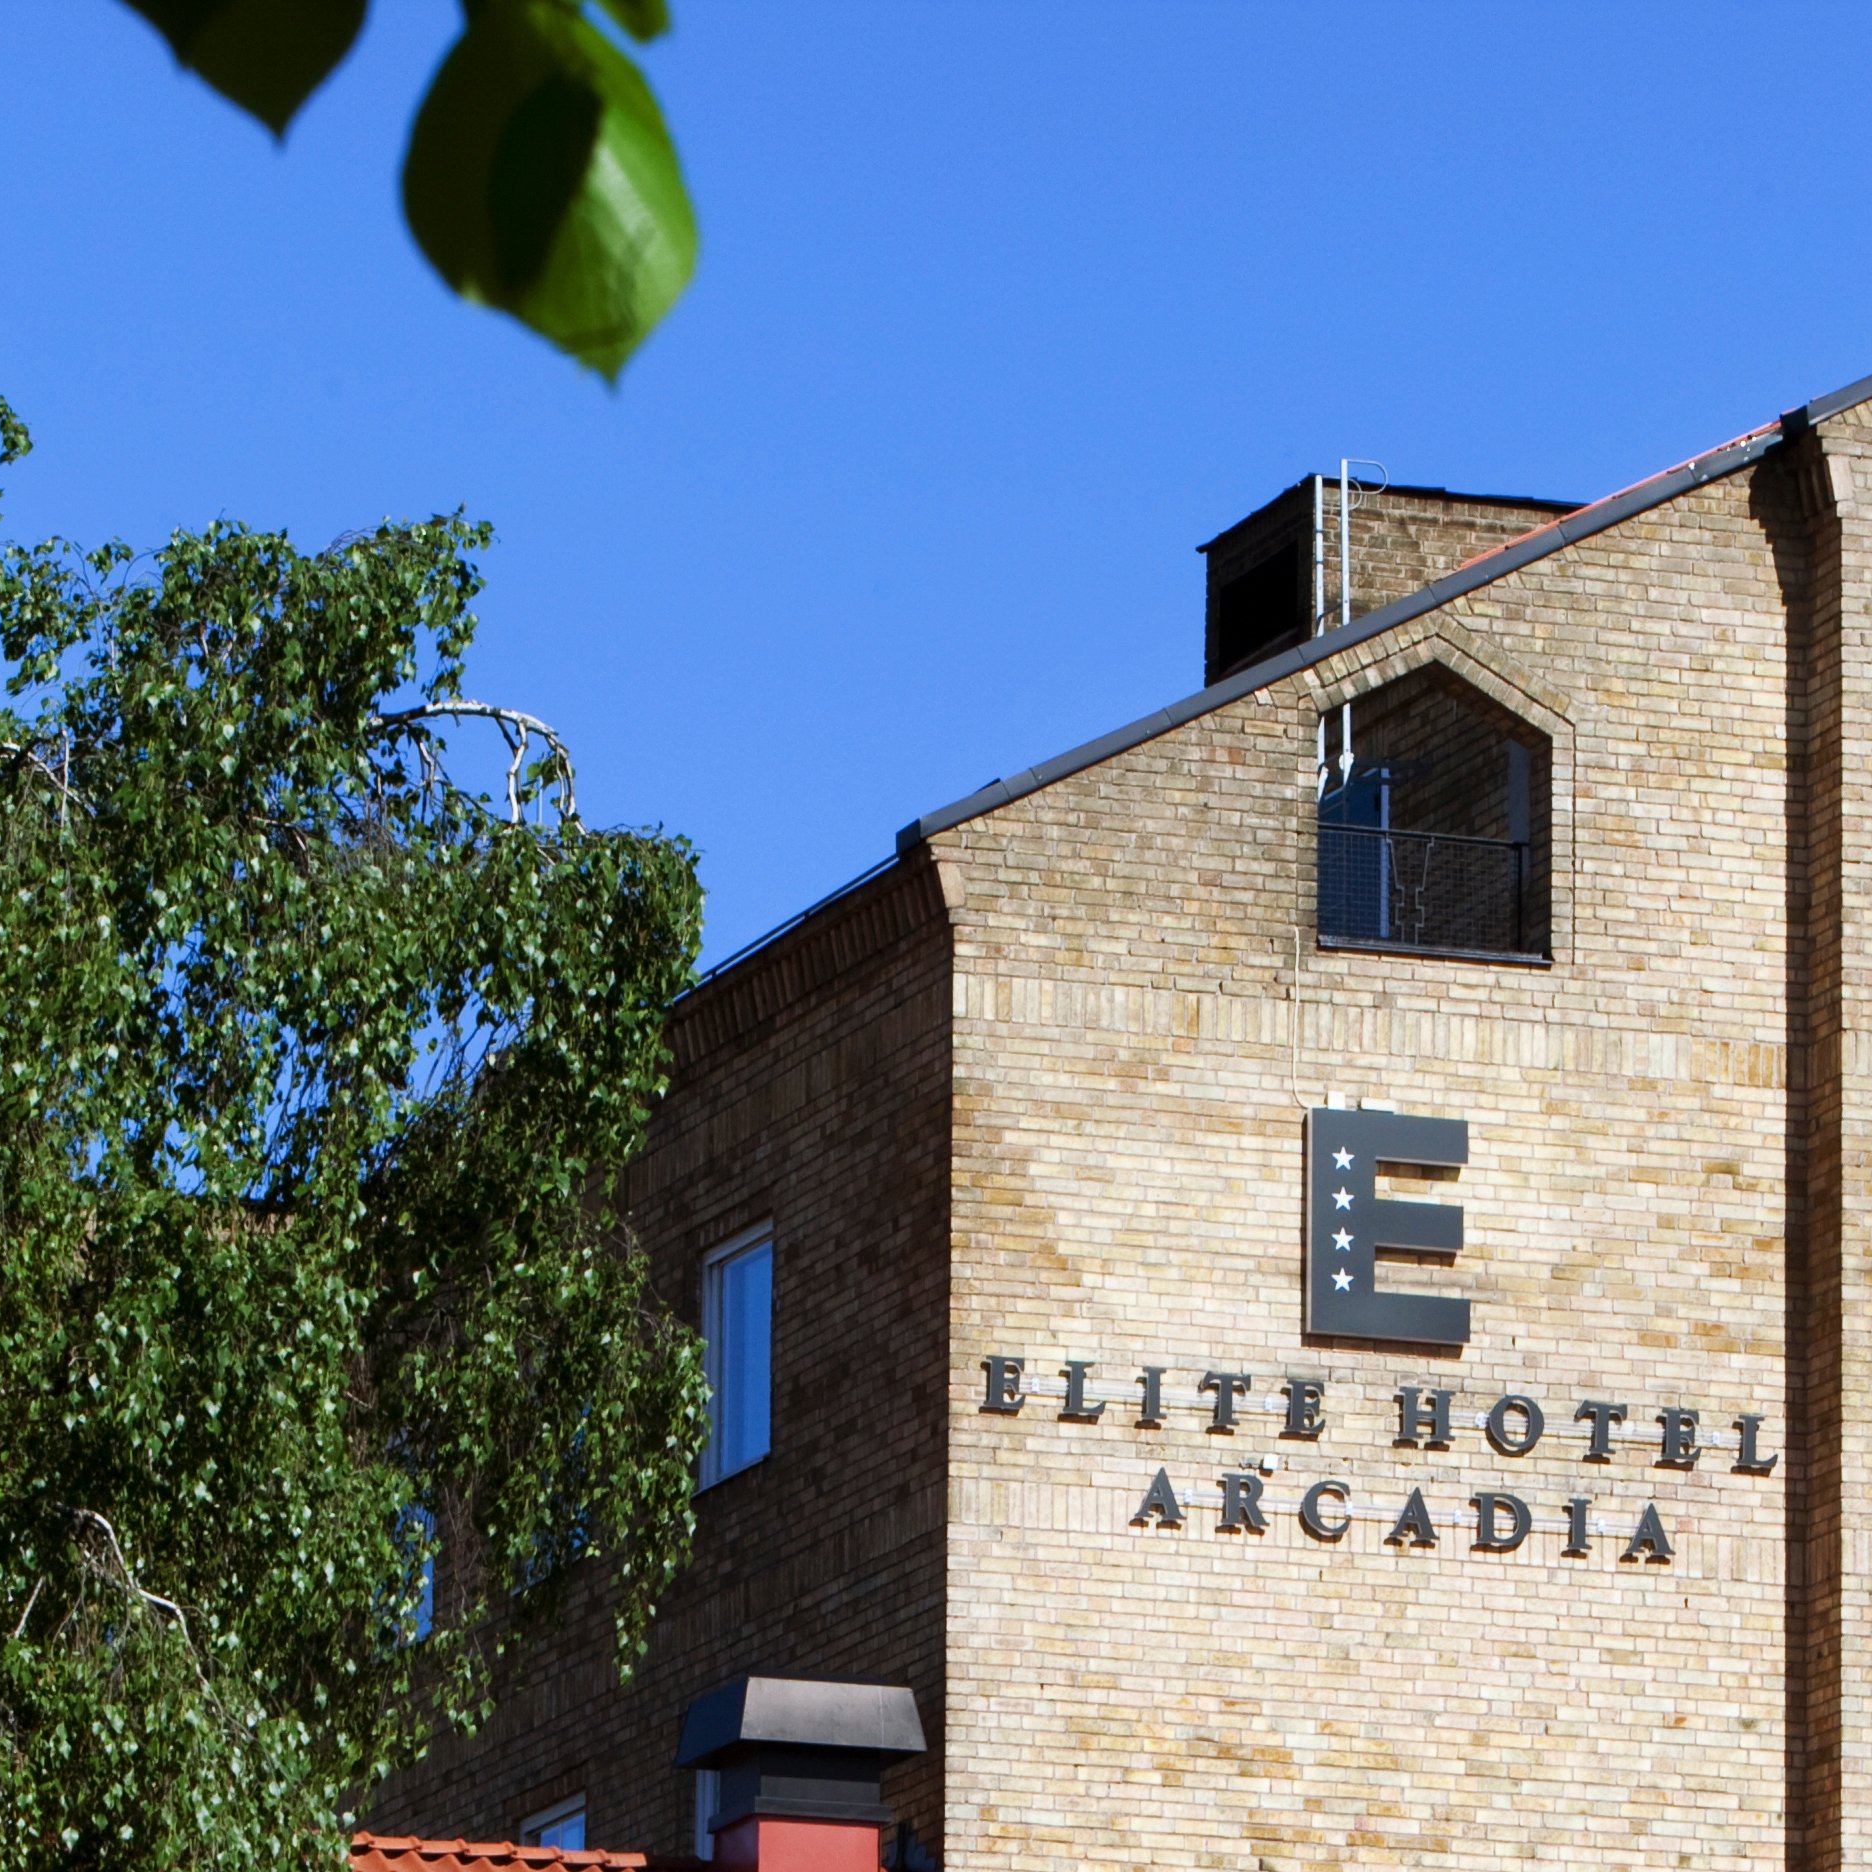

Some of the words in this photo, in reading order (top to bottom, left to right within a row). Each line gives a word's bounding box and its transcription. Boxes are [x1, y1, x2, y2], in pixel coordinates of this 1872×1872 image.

[1305, 1106, 1471, 1345] E
[981, 1354, 1327, 1437] ELITE
[1394, 1386, 1779, 1473] HOTEL
[1133, 1466, 1677, 1560] ARCADIA
